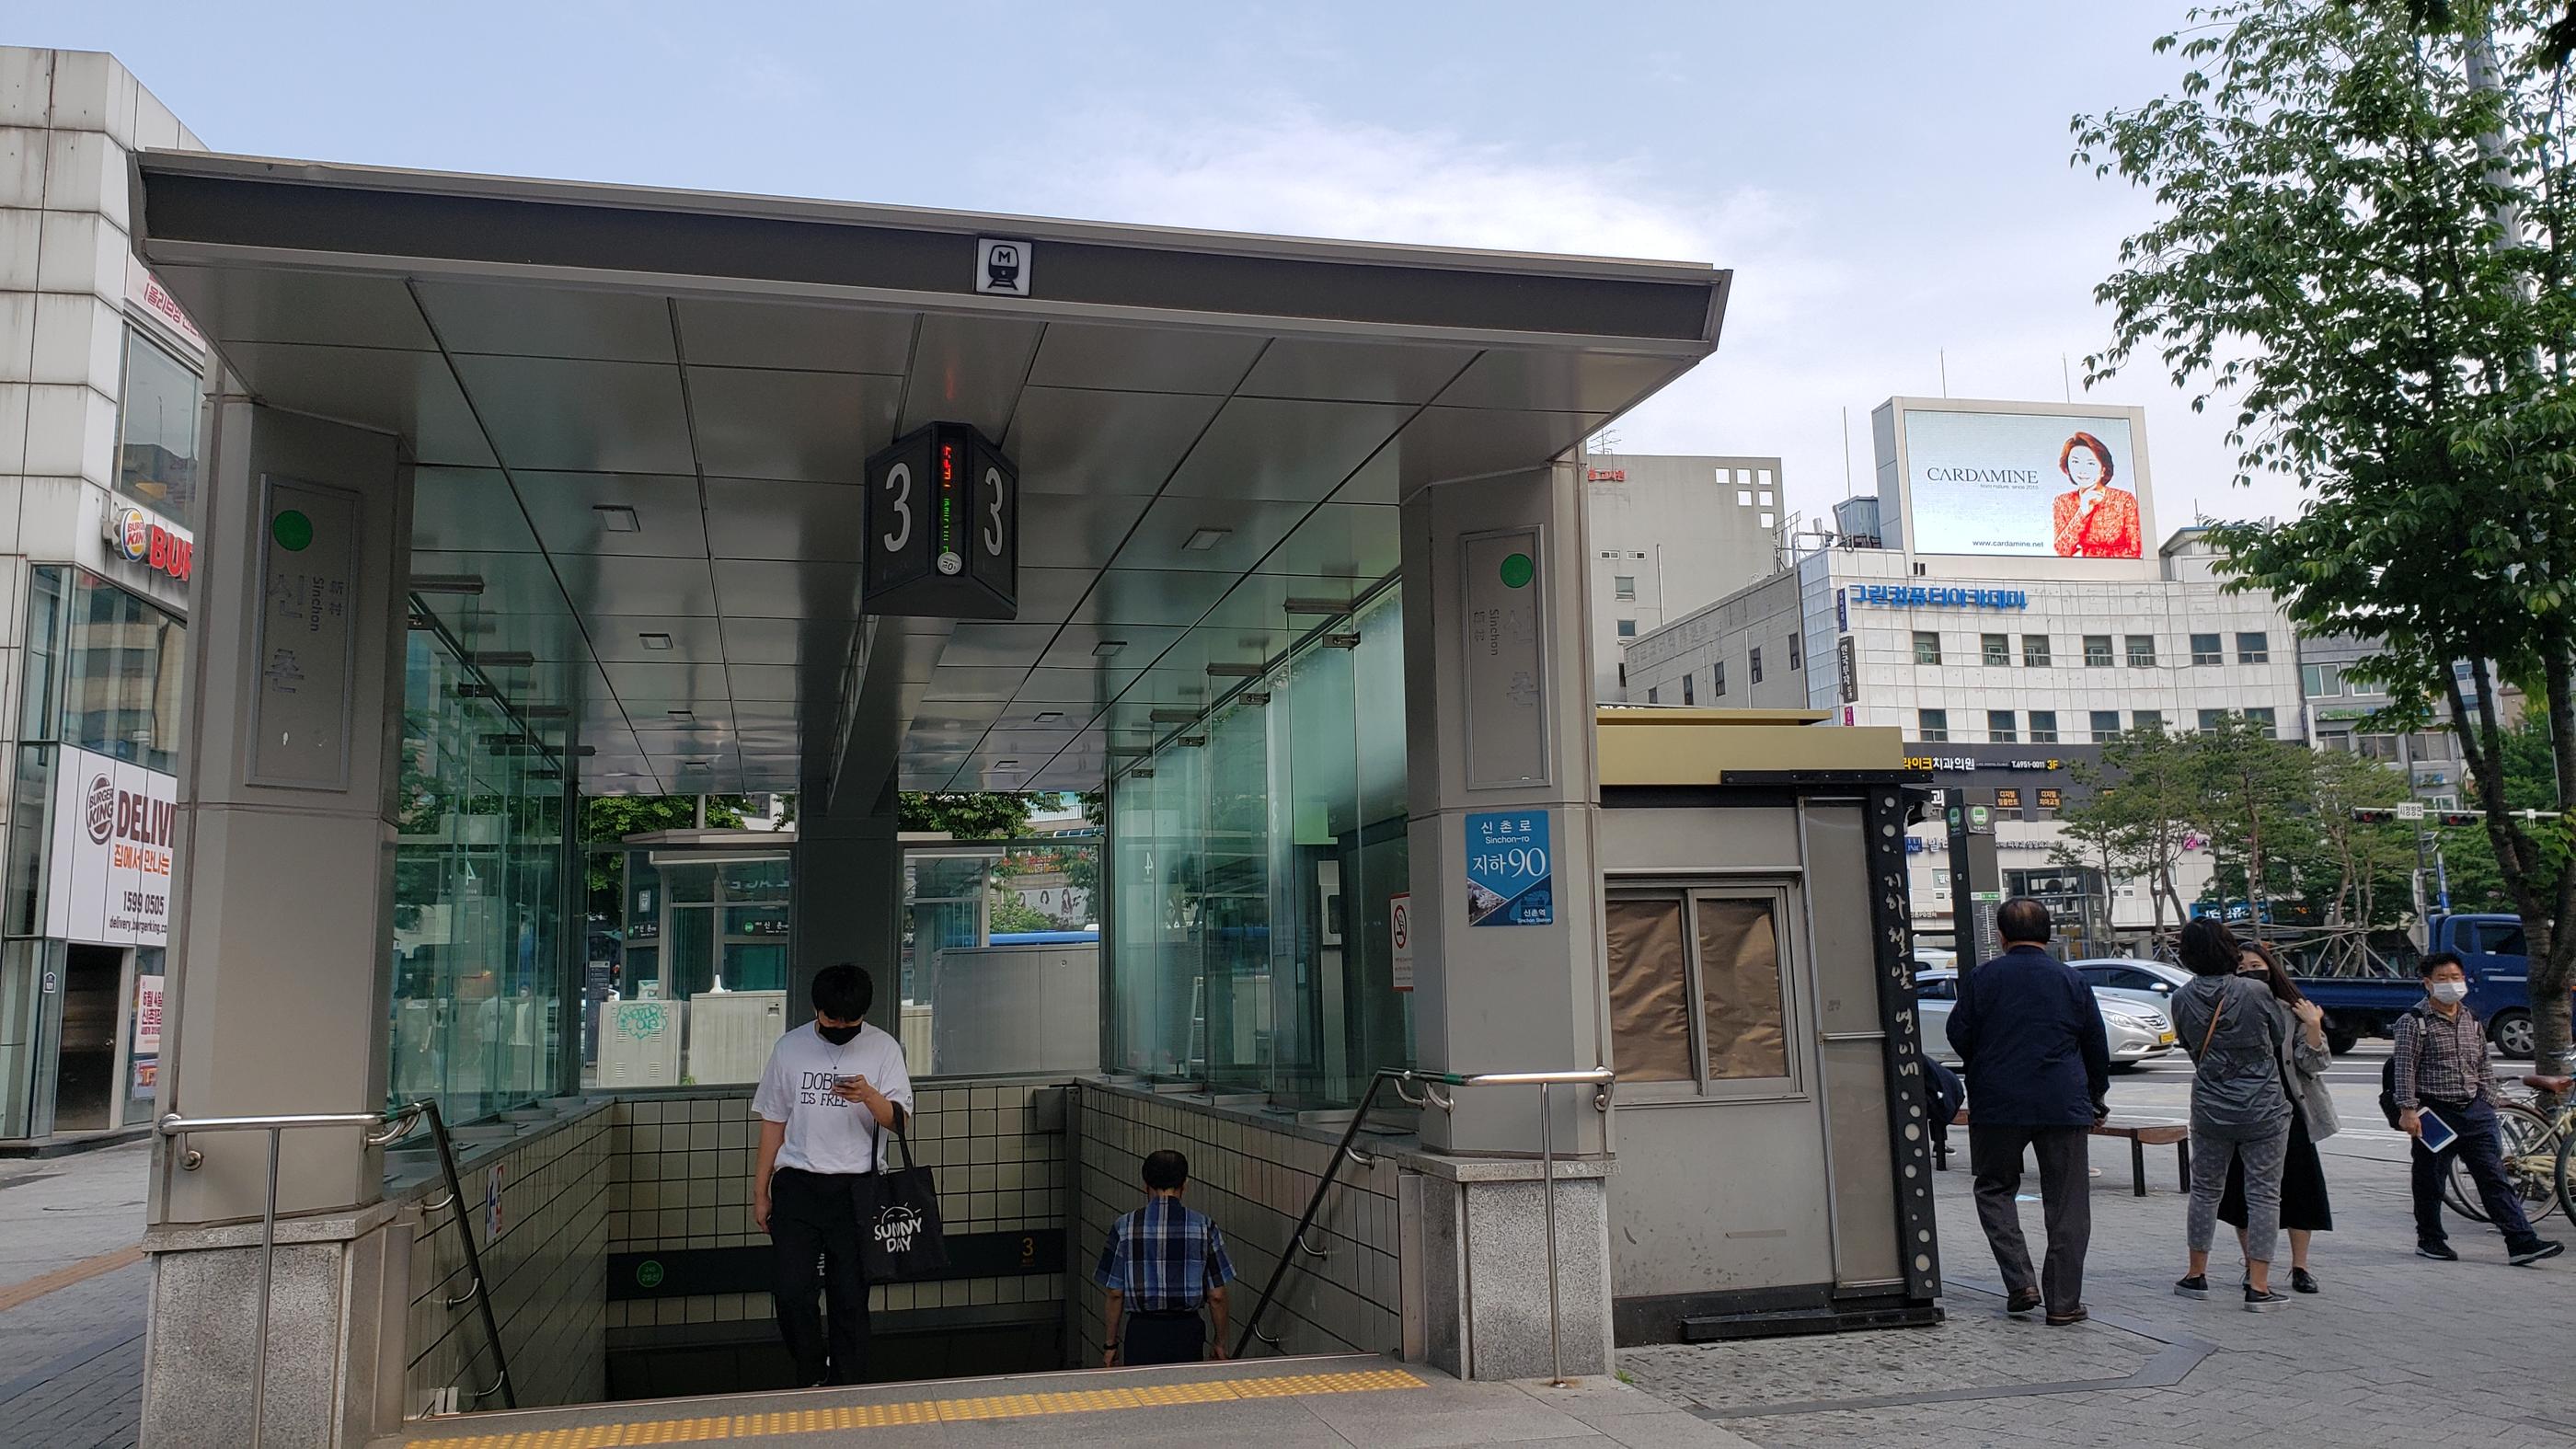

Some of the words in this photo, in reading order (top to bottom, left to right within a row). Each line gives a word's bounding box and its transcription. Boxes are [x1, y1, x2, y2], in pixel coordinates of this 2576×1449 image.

[998, 250, 1011, 263] M
[1926, 467, 2039, 484] CARDAMINE
[884, 463, 911, 552] 3
[983, 466, 1004, 556] 3
[311, 576, 324, 632] Sinchon
[1849, 583, 2029, 610] 그린컴퓨터아카데미
[1489, 608, 1501, 656] Sinchon
[2047, 760, 2059, 770] 3F
[88, 788, 113, 809] BURGER
[88, 800, 113, 828] KING
[1485, 835, 1530, 845] Sinchon-ro
[114, 844, 142, 870] 집에서
[144, 849, 170, 876] 만나는
[123, 891, 143, 913] 1599
[144, 893, 165, 915] 0505
[800, 1092, 817, 1105] IS
[821, 1093, 848, 1108] FREE
[874, 1217, 922, 1241] SUNNY
[886, 1236, 912, 1253] DAY
[1022, 1237, 1034, 1257] 3
